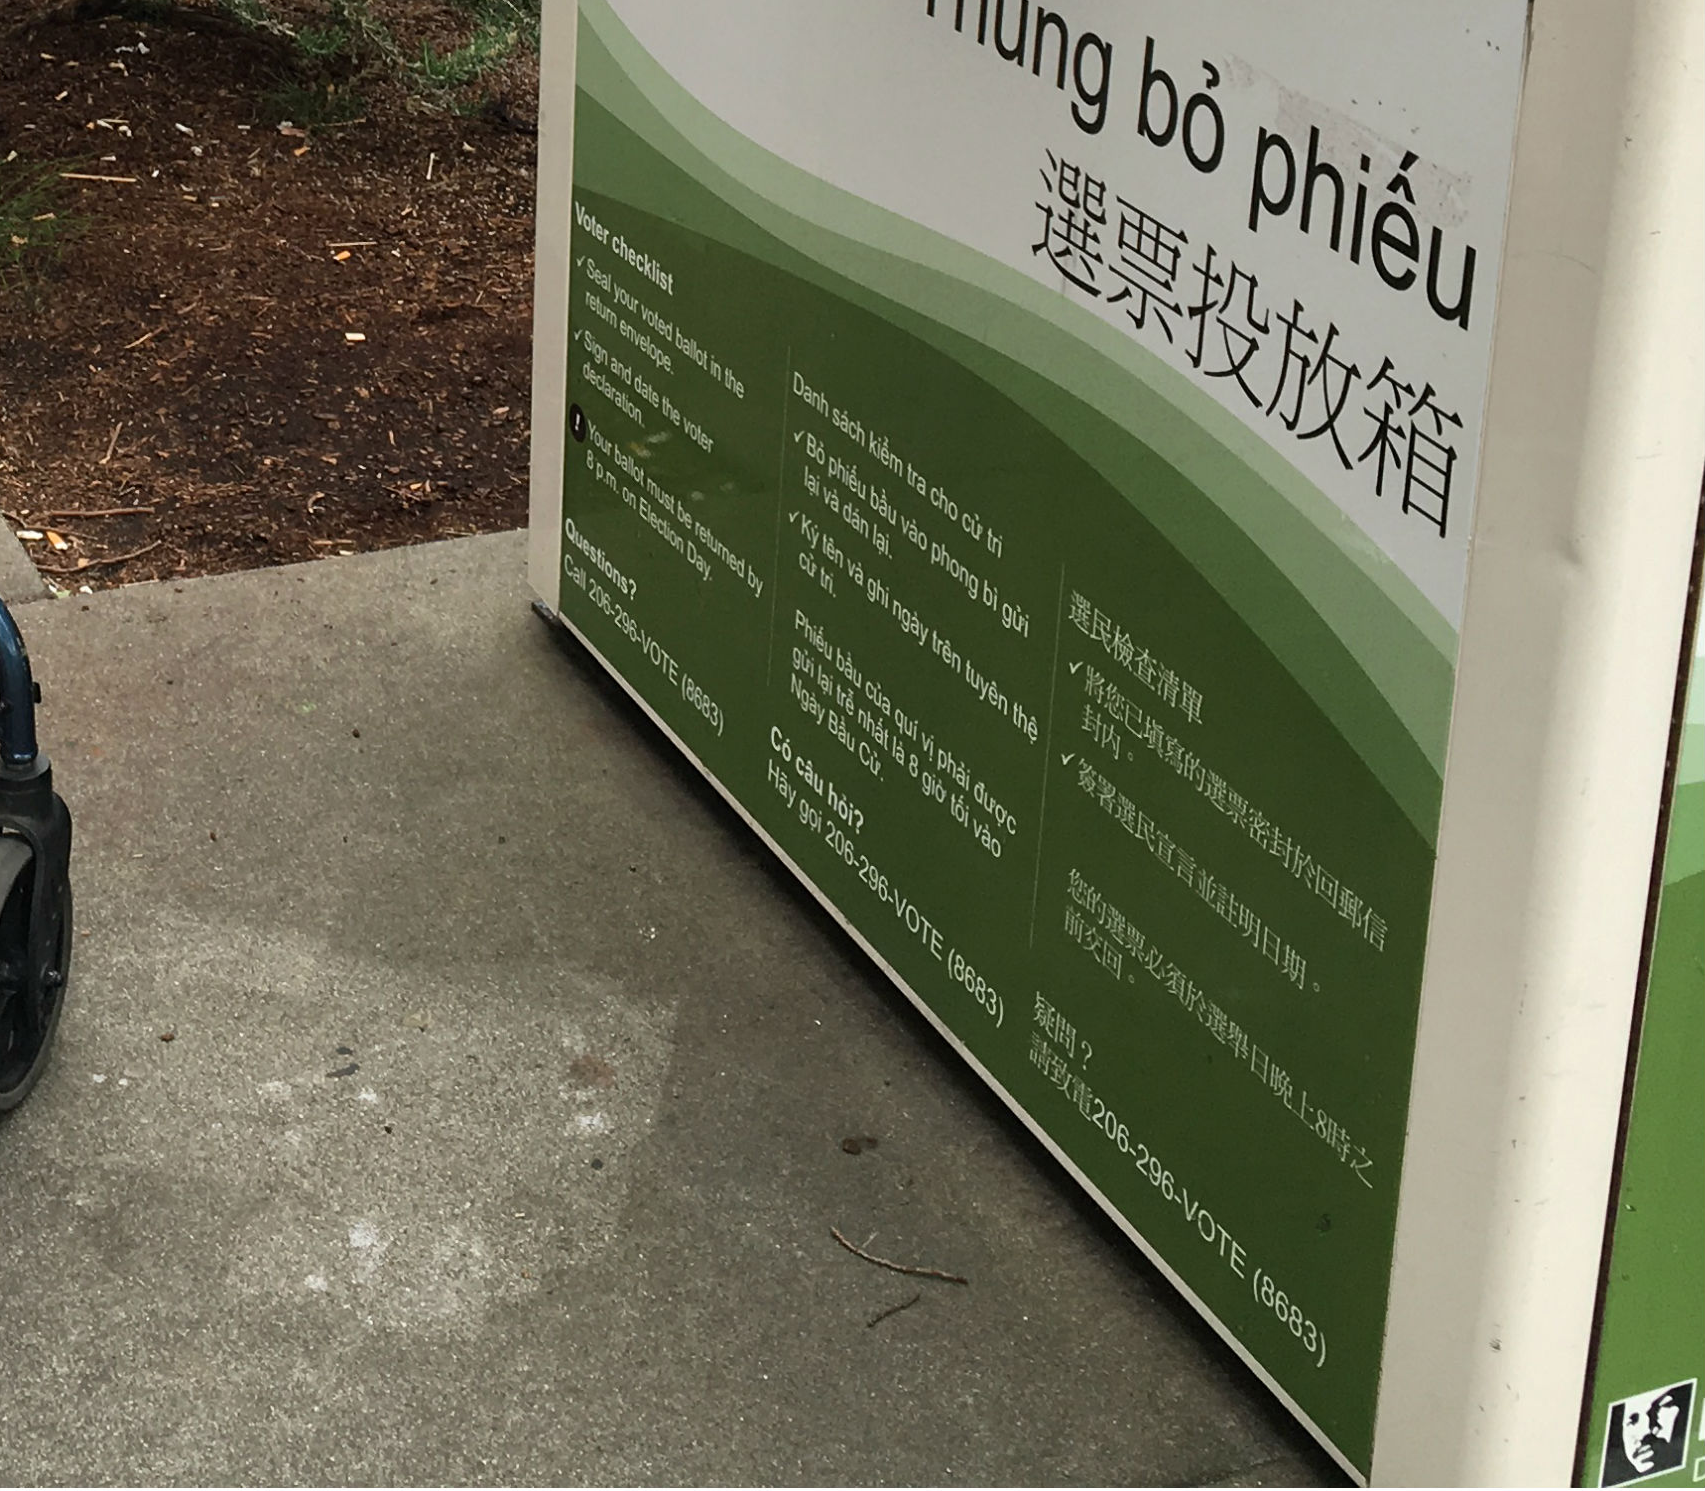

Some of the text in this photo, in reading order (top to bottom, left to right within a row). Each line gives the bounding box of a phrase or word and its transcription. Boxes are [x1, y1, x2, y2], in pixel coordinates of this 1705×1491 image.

[1141, 38, 1226, 176] bỏ
[1250, 125, 1478, 330] phiếu
[575, 201, 674, 297] Voter checklist
[585, 291, 675, 375] return envelope.
[586, 257, 745, 399] Seal your voted ballot in the
[1031, 147, 1464, 539] 選票投放箱
[582, 361, 645, 428] declaration.
[583, 329, 714, 454] Sign and date the voter
[586, 448, 713, 582] 8 p.m. on Election Day.
[587, 418, 764, 599] Your ballot must be returned by
[792, 370, 829, 418] Danh
[906, 462, 927, 497] tra
[929, 486, 959, 522] cho
[987, 527, 1003, 559] tri
[565, 517, 637, 601] Questions?
[820, 566, 837, 599] tri.
[866, 577, 890, 609] ghi
[930, 541, 979, 600] phong
[565, 554, 724, 737] Call 206-296-VOTE (8683)
[908, 753, 919, 778] 8
[824, 819, 944, 962] 206-296-VOTE
[947, 947, 1004, 1029] (8683)
[1253, 1267, 1327, 1368] (8683)
